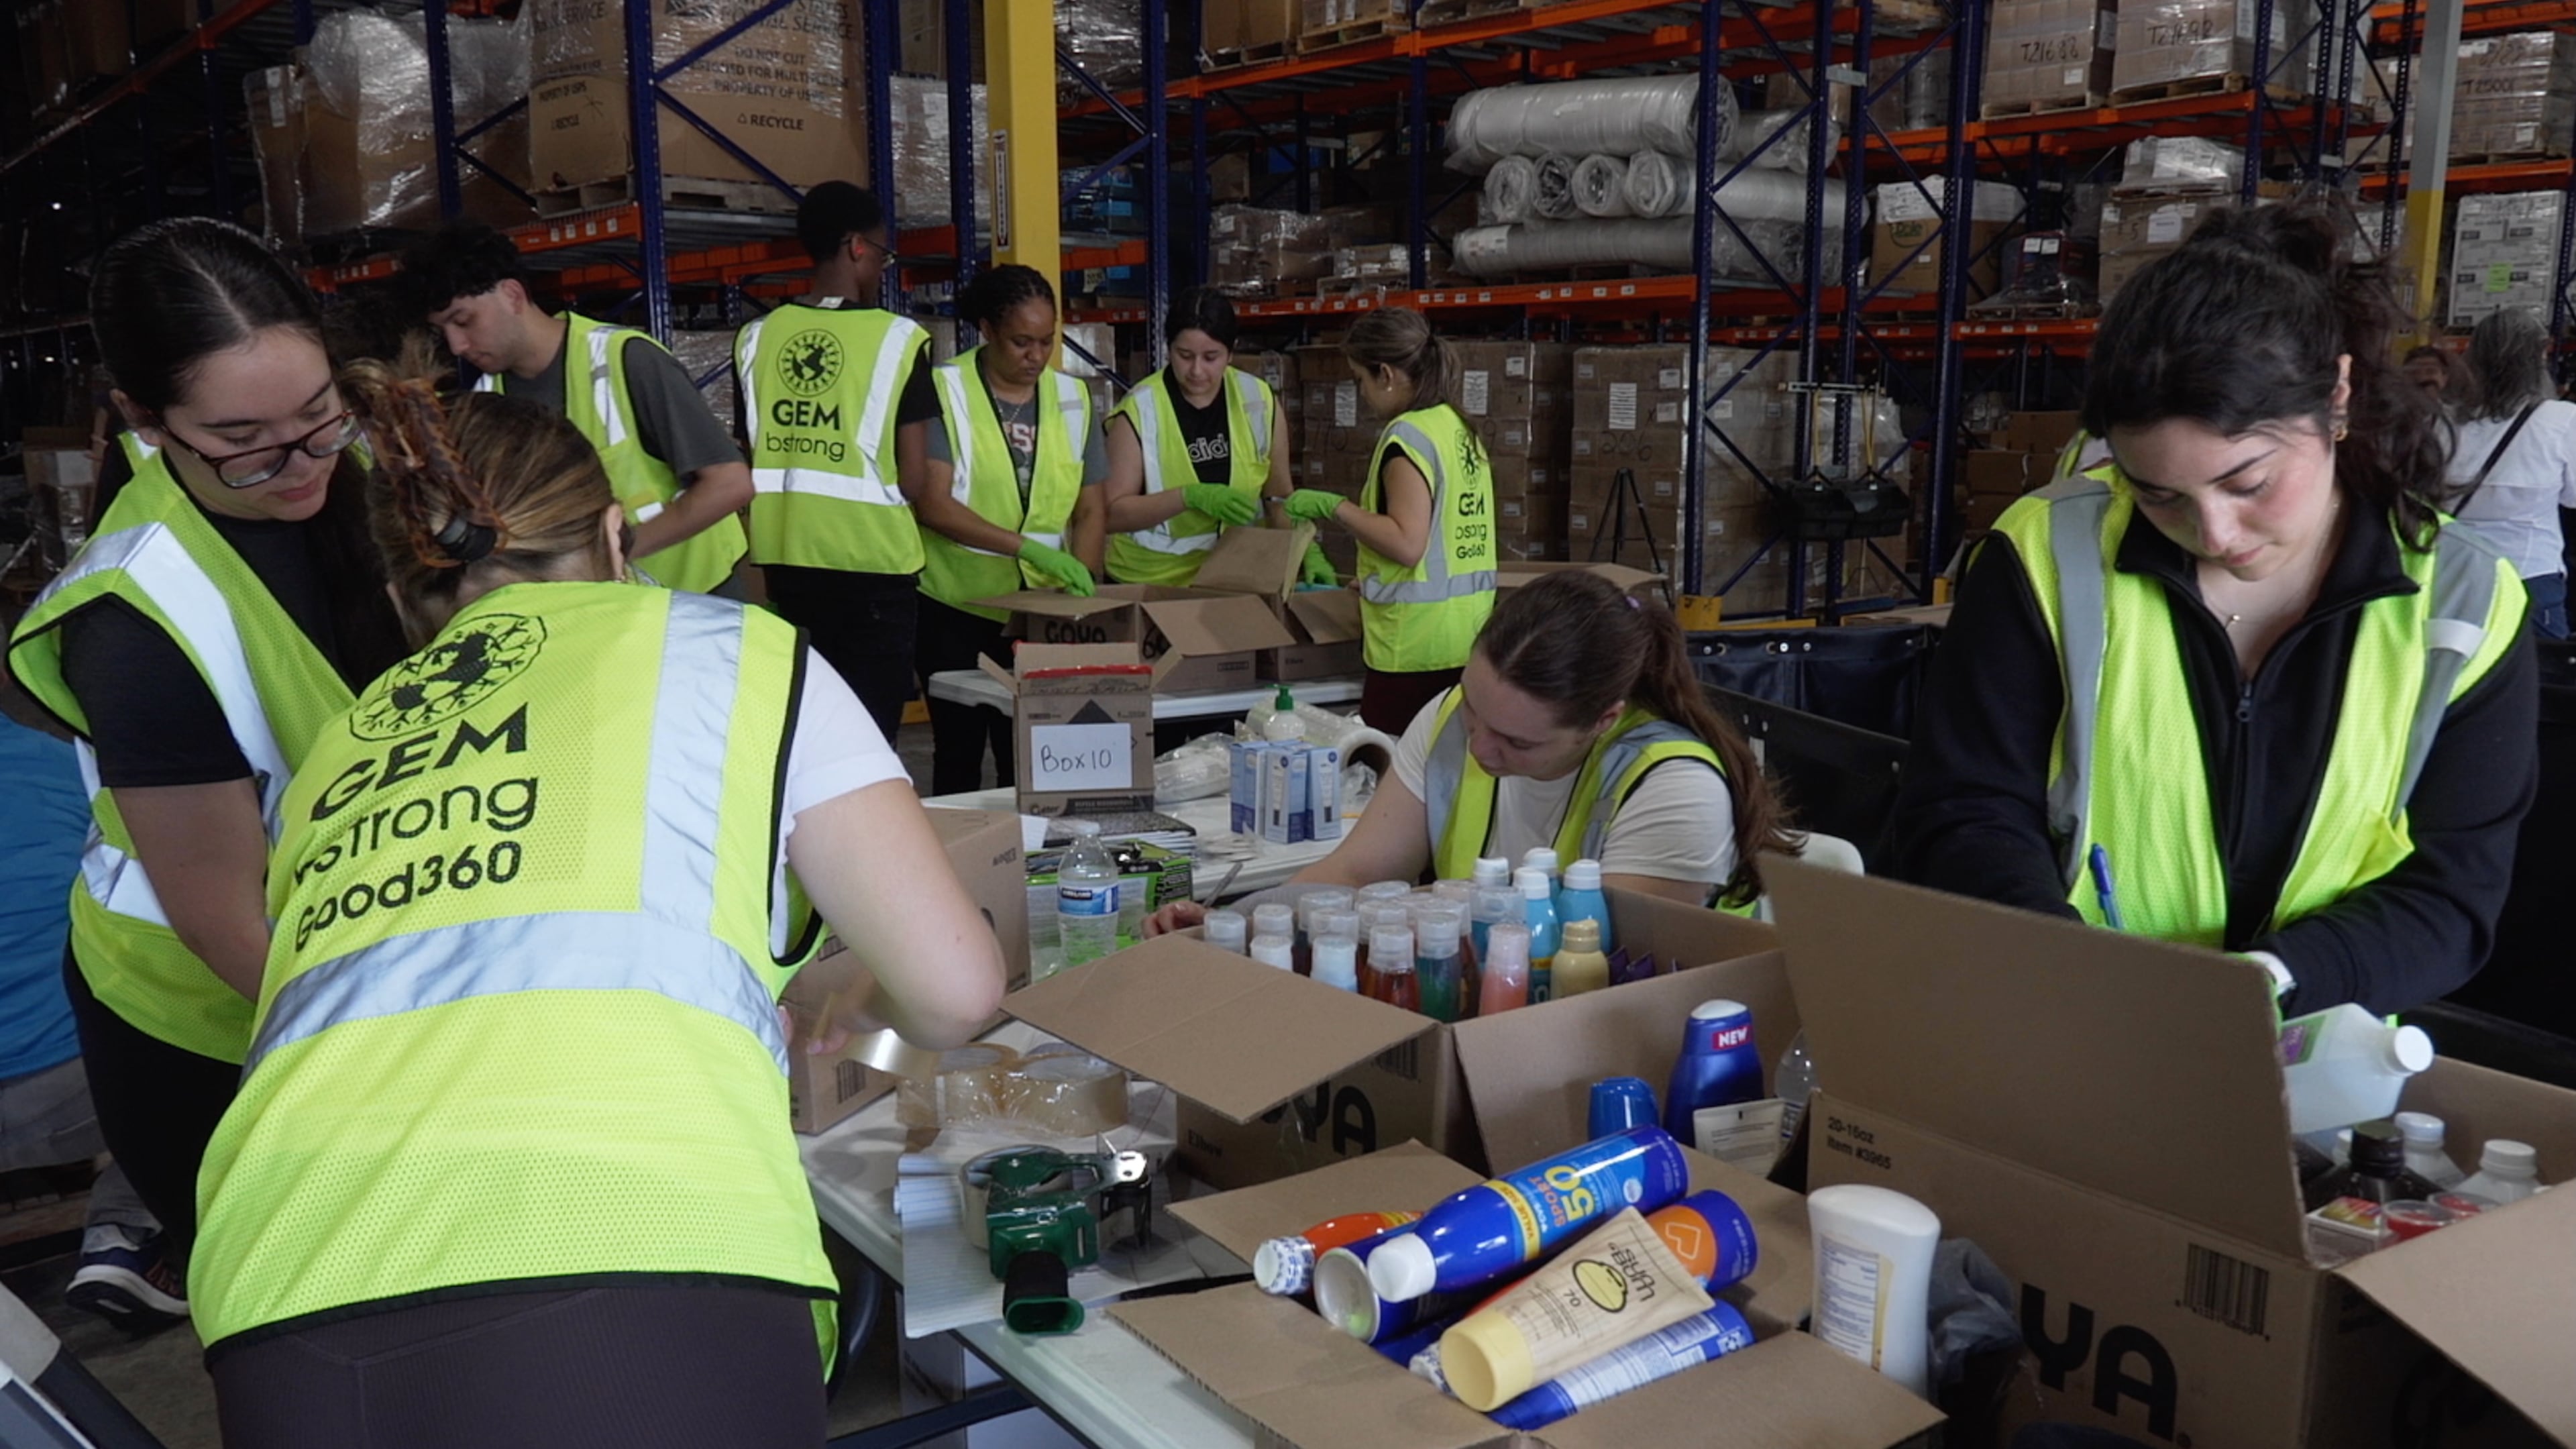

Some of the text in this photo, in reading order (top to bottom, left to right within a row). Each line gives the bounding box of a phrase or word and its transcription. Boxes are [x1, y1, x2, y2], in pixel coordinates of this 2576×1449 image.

[783, 51, 806, 65] CUT
[750, 113, 804, 131] RECYCLE
[772, 400, 841, 431] GEM
[766, 431, 845, 462] bstrong
[311, 702, 529, 822] GEM
[1040, 744, 1112, 773] Box 10
[295, 841, 521, 953] Good360
[1718, 1025, 1748, 1048] NEW
[1527, 1176, 1566, 1227] SPORT
[1544, 1165, 1595, 1222] 50
[1562, 1289, 1582, 1307] 70
[2020, 1282, 2179, 1442] YA
